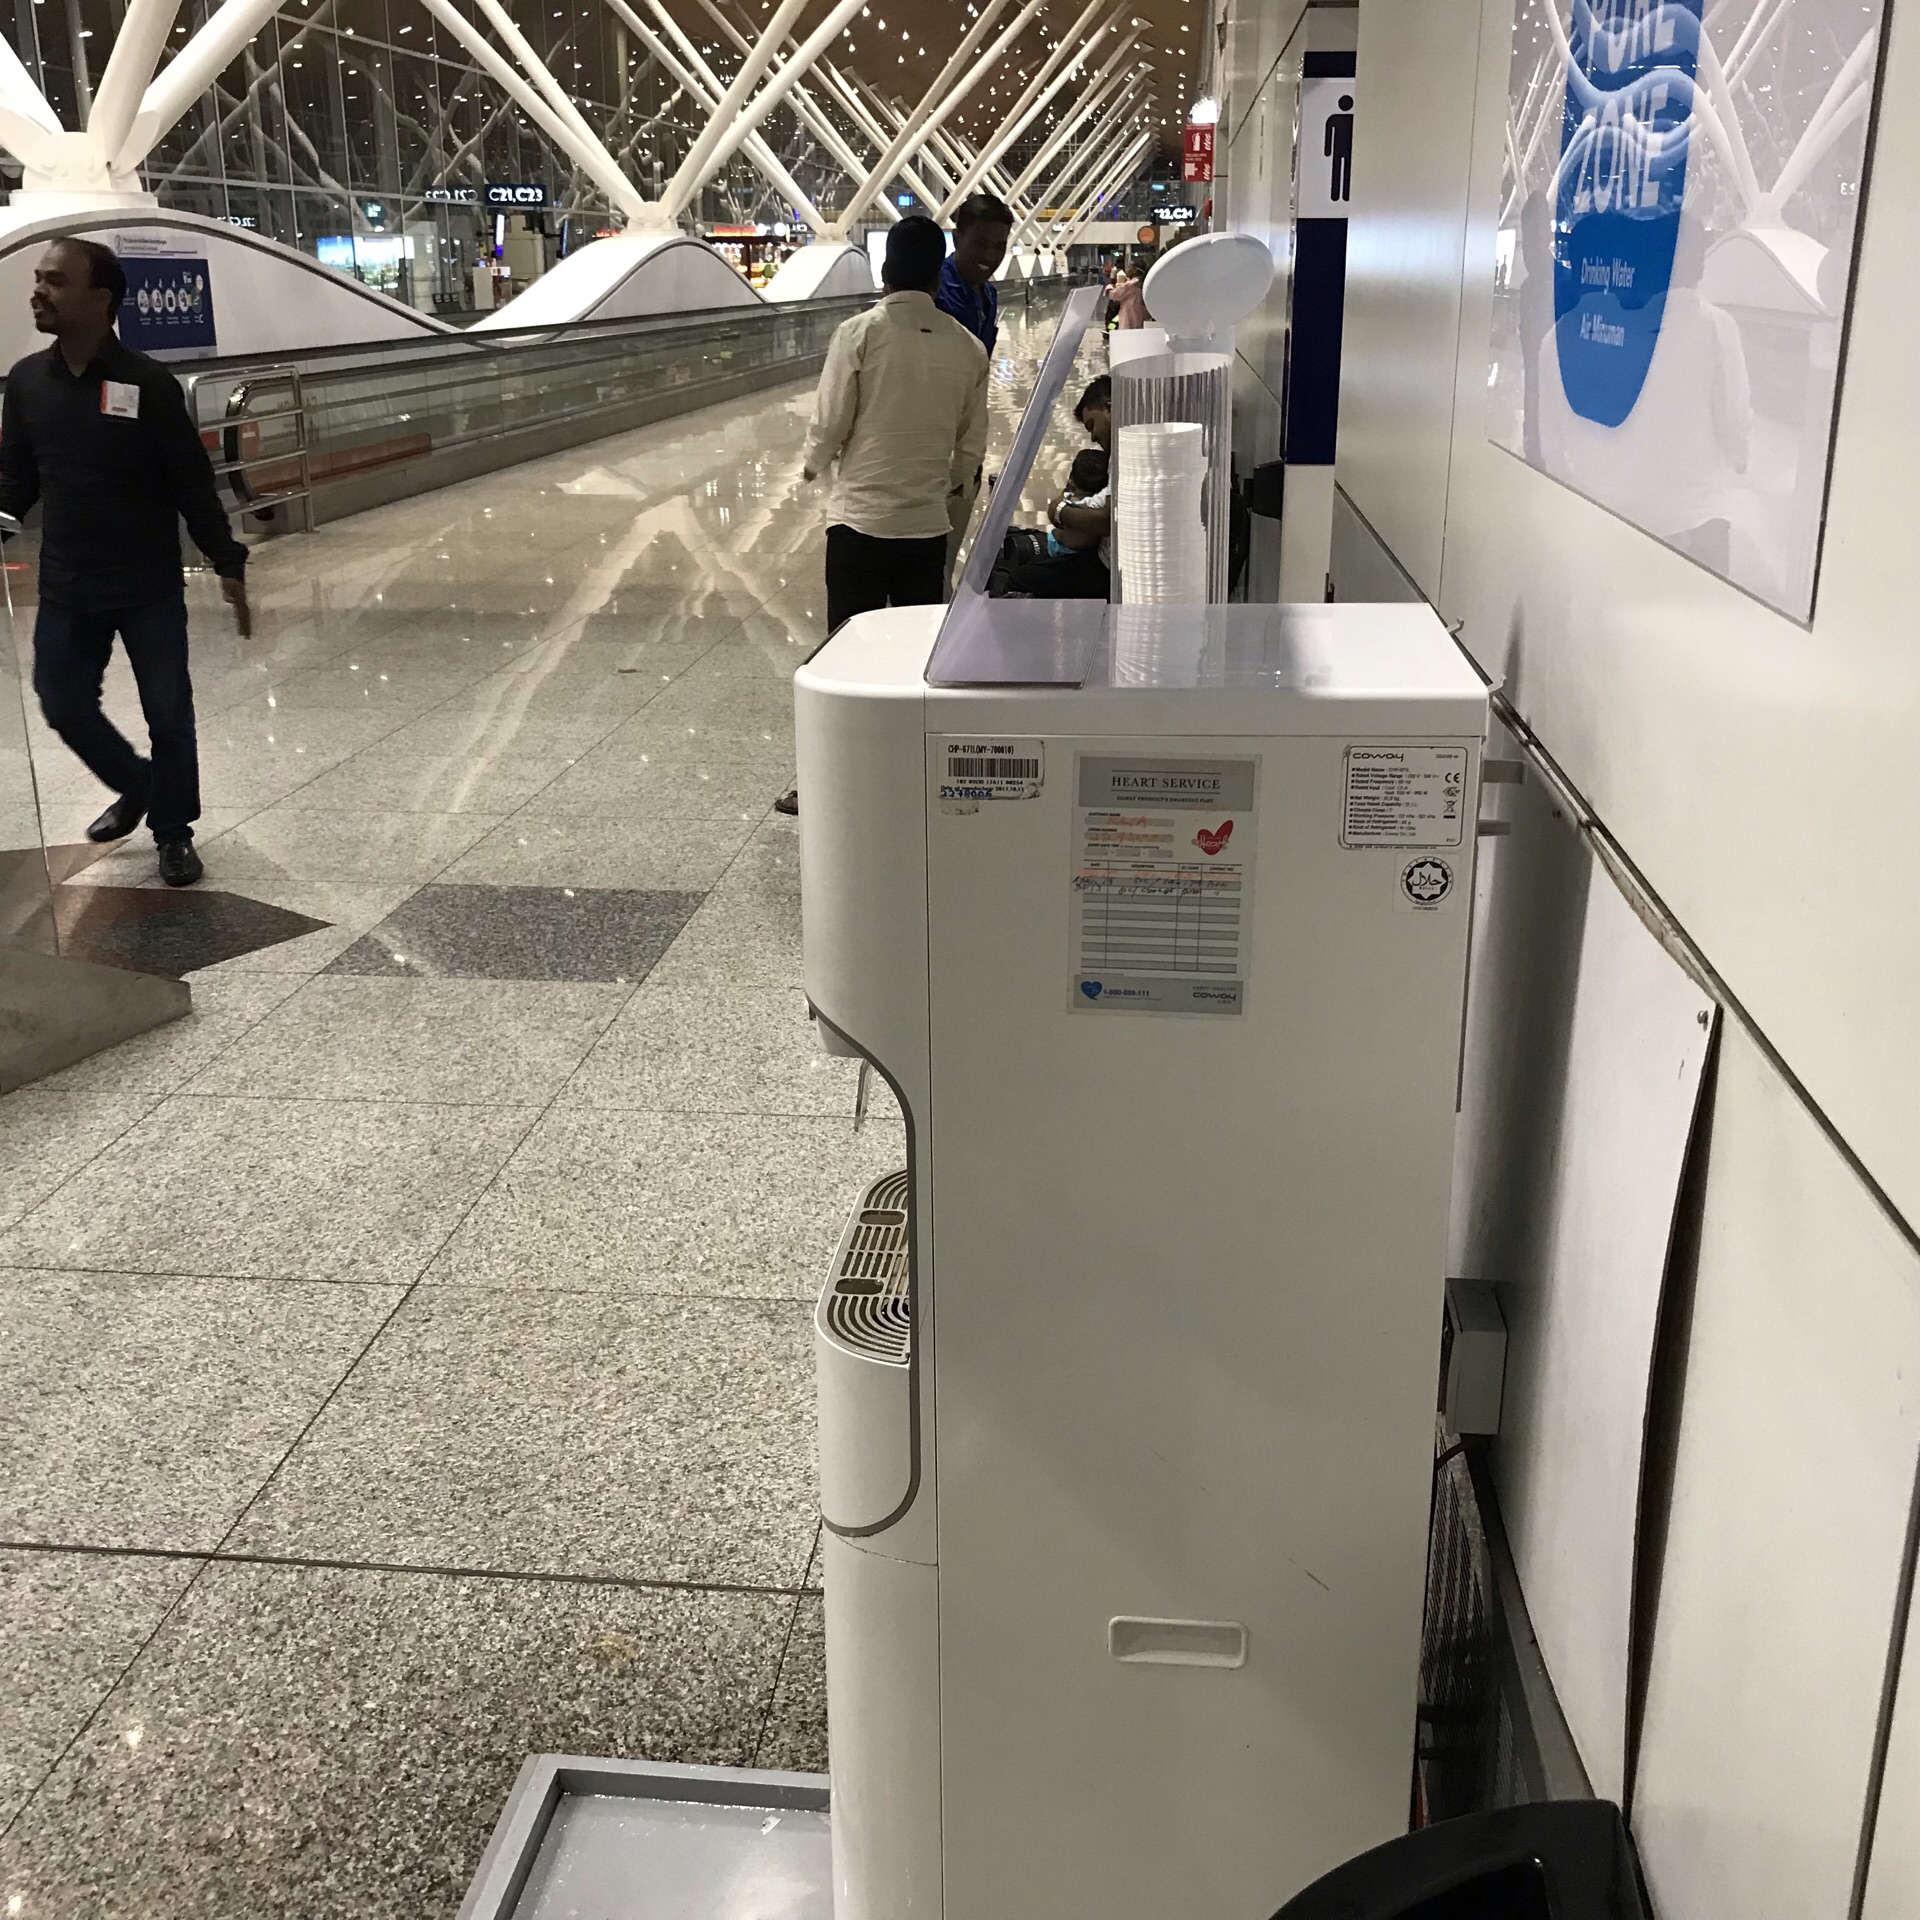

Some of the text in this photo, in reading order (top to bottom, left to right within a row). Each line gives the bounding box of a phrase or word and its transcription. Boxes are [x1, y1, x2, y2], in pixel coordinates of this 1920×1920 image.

[1573, 82, 1669, 214] ZONE
[489, 187, 543, 205] C21,C23
[1581, 256, 1635, 295] Drinking Water
[1580, 312, 1625, 347] Air Minuman
[1353, 753, 1404, 762] coway
[1112, 776, 1221, 790] HEART SERVICE
[1192, 992, 1236, 1002] coway
